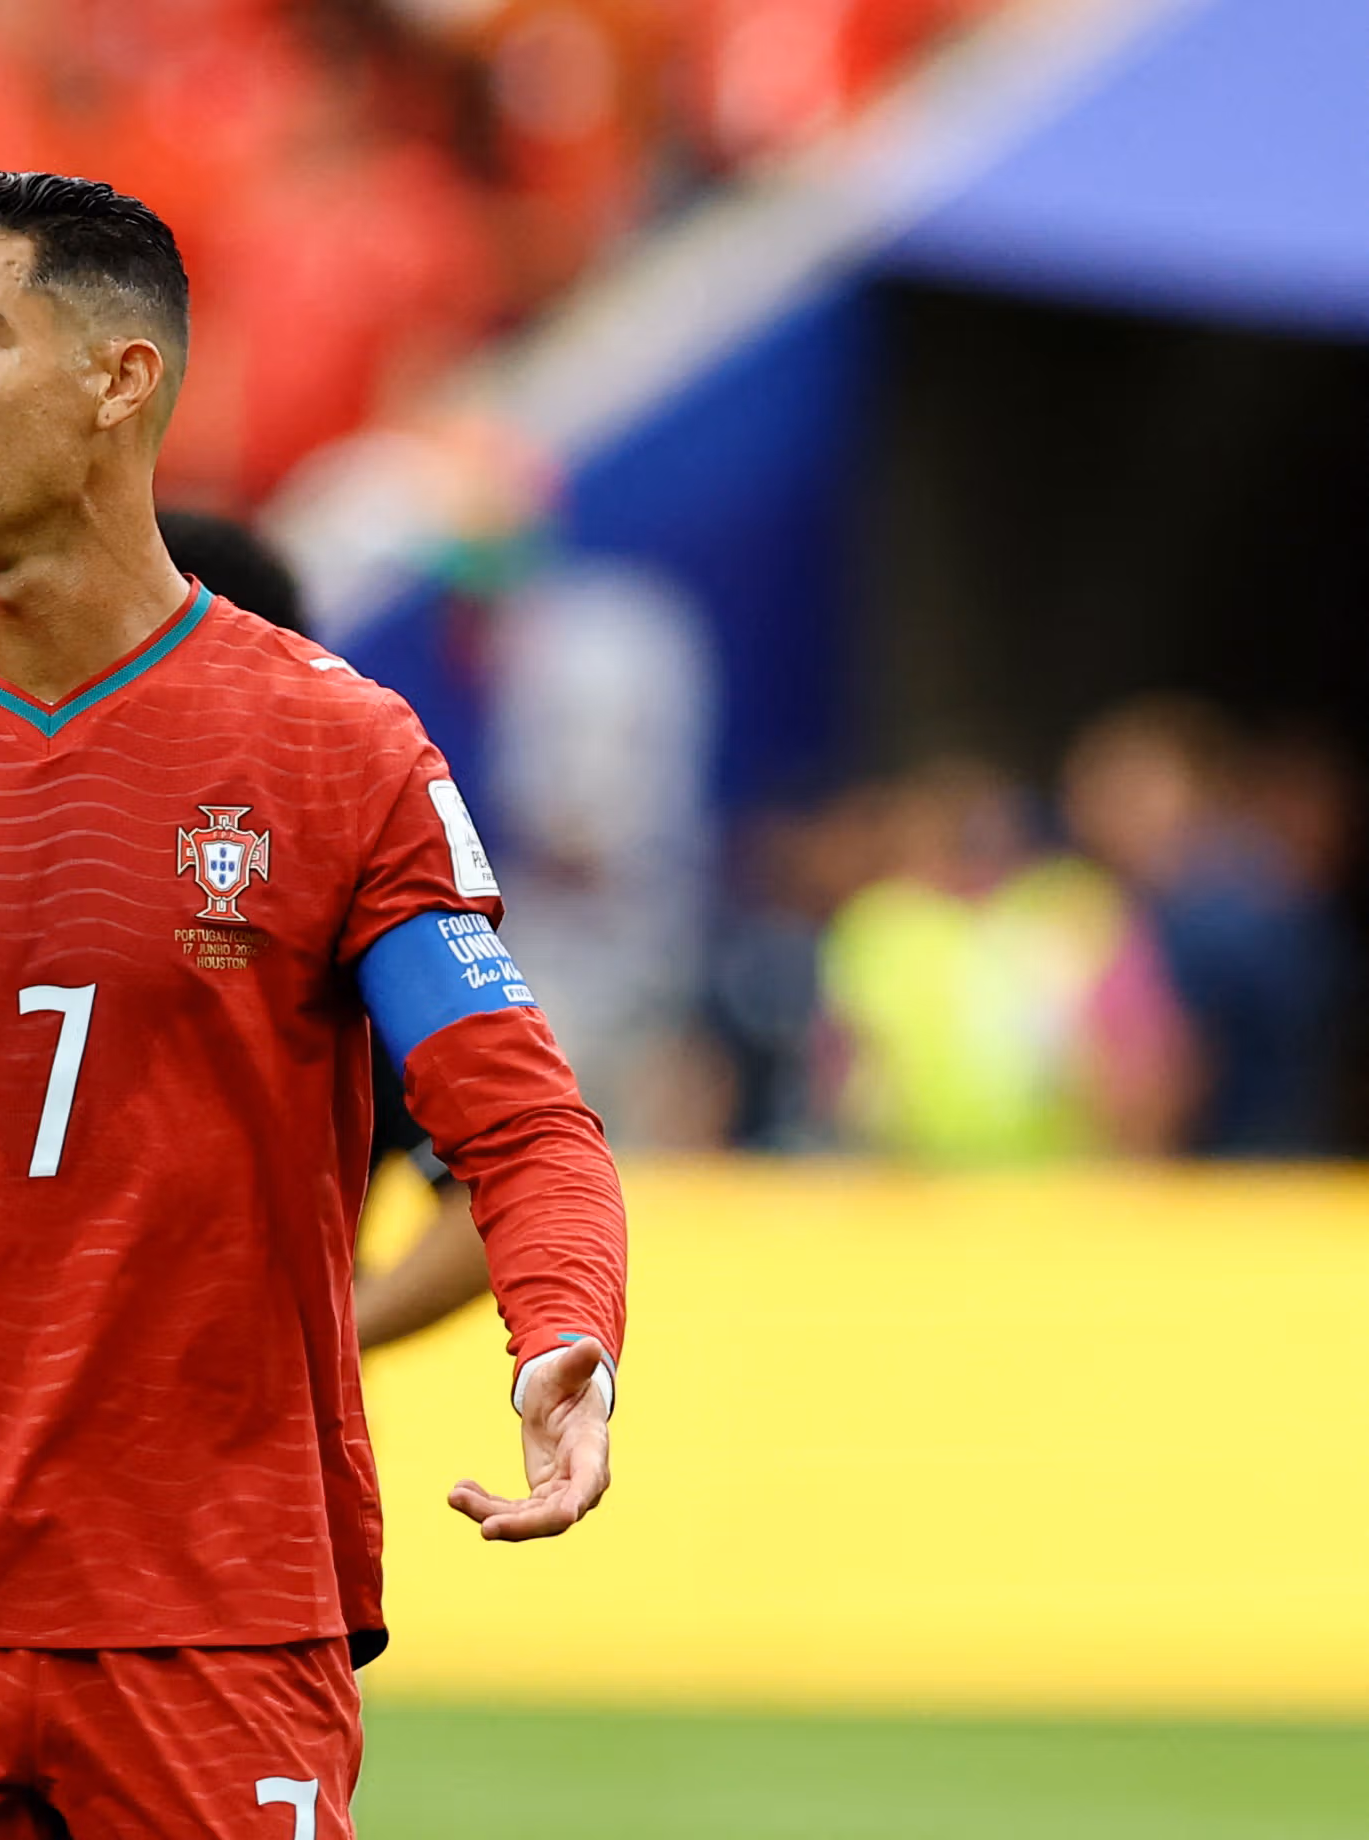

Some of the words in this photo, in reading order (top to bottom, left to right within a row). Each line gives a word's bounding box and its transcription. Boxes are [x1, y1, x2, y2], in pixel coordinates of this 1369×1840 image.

[183, 942, 194, 955] 17
[198, 943, 230, 955] JUNHO
[448, 933, 511, 964] UNIT
[197, 957, 247, 970] HOUSTON
[461, 963, 501, 988] the
[19, 983, 97, 1178] 7
